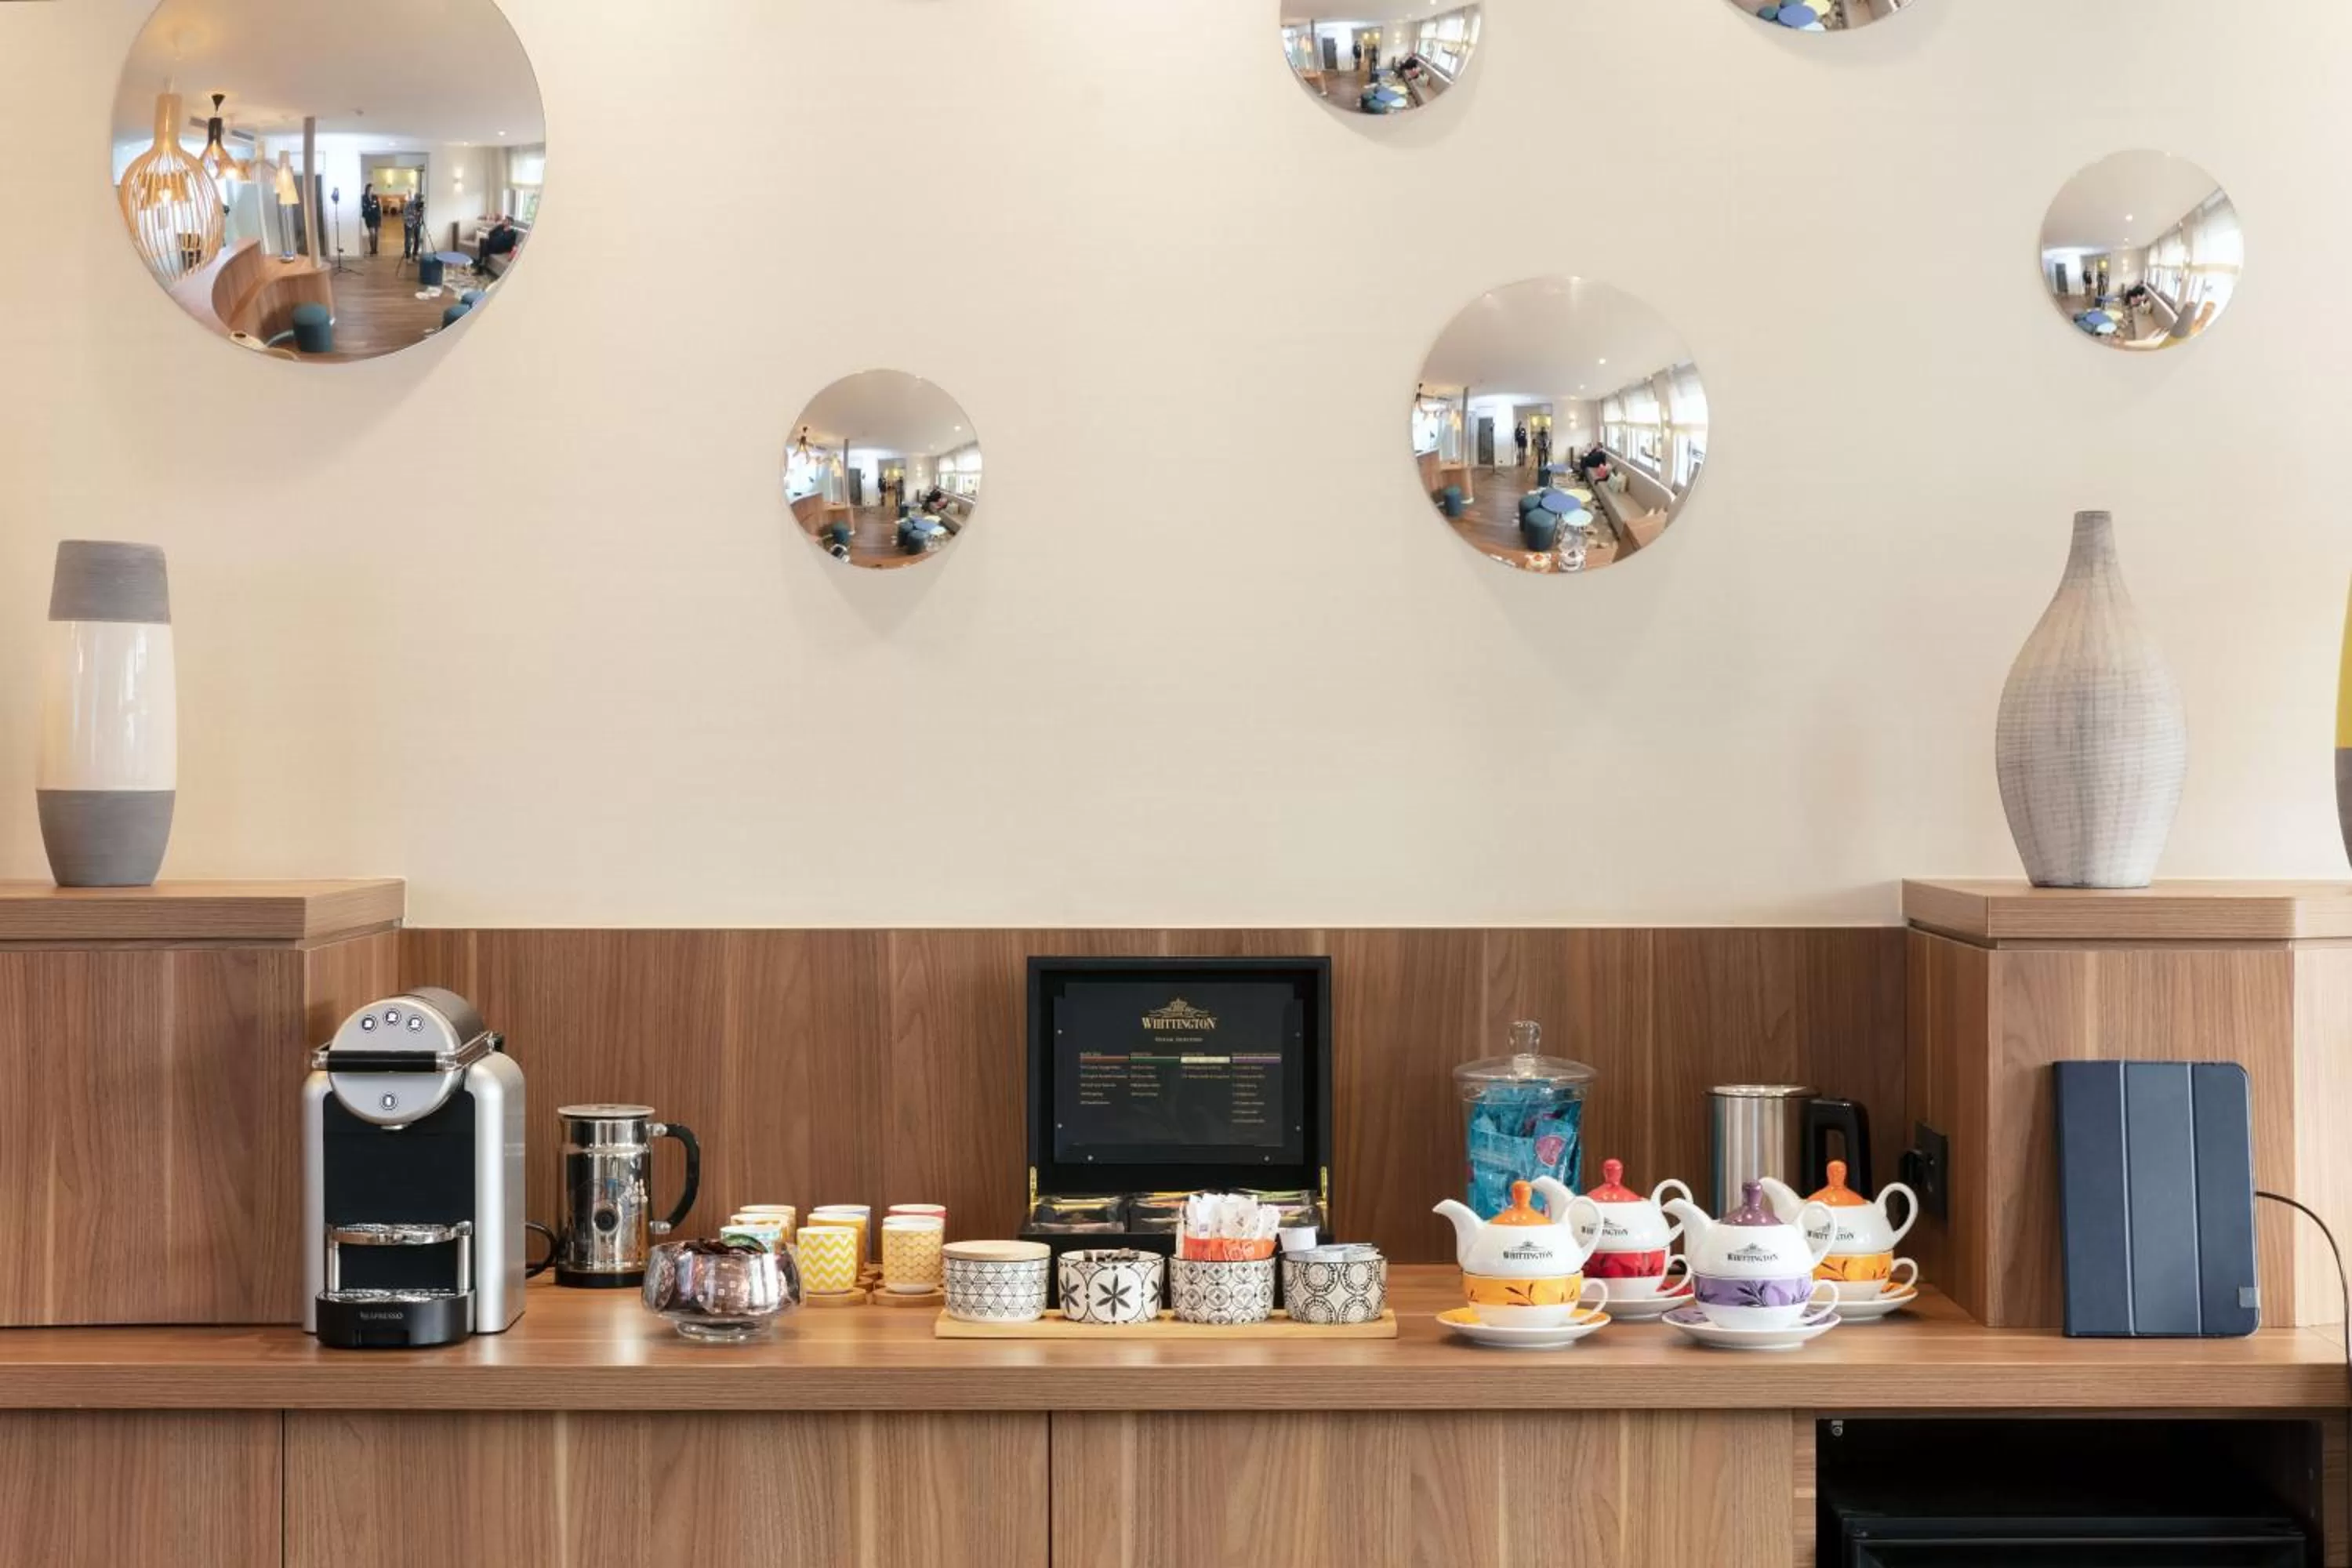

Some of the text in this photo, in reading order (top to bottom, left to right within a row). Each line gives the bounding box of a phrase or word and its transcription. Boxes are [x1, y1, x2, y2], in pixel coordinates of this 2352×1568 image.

[1142, 1017, 1217, 1029] WHITTINGTON
[1581, 1225, 1629, 1236] WHIINGTON
[1806, 1229, 1855, 1241] WHITTGTON
[1502, 1250, 1553, 1260] WHITTINGTON
[1727, 1252, 1779, 1261] WHITTINGTON
